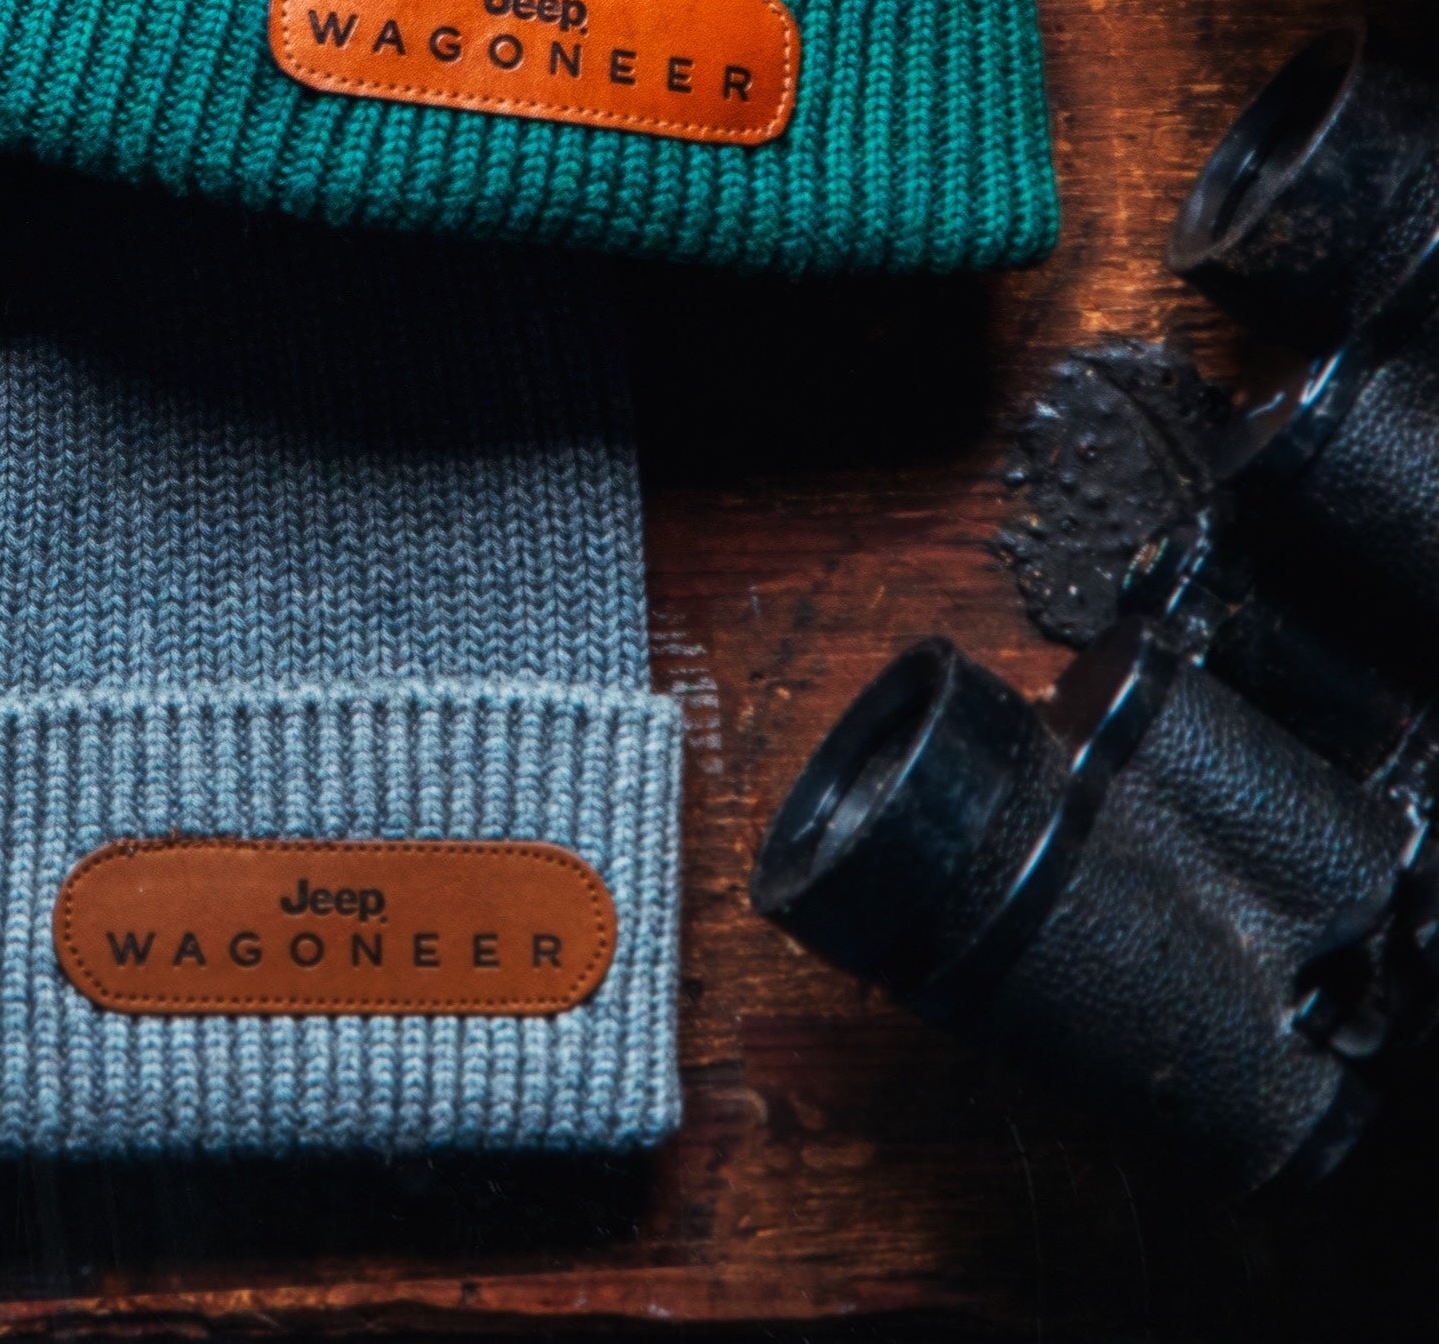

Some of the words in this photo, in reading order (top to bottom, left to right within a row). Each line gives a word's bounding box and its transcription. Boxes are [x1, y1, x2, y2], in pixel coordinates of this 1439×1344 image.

[308, 8, 753, 102] WAGONEER
[279, 879, 388, 923] Jeep
[105, 930, 564, 969] WAGONEER
